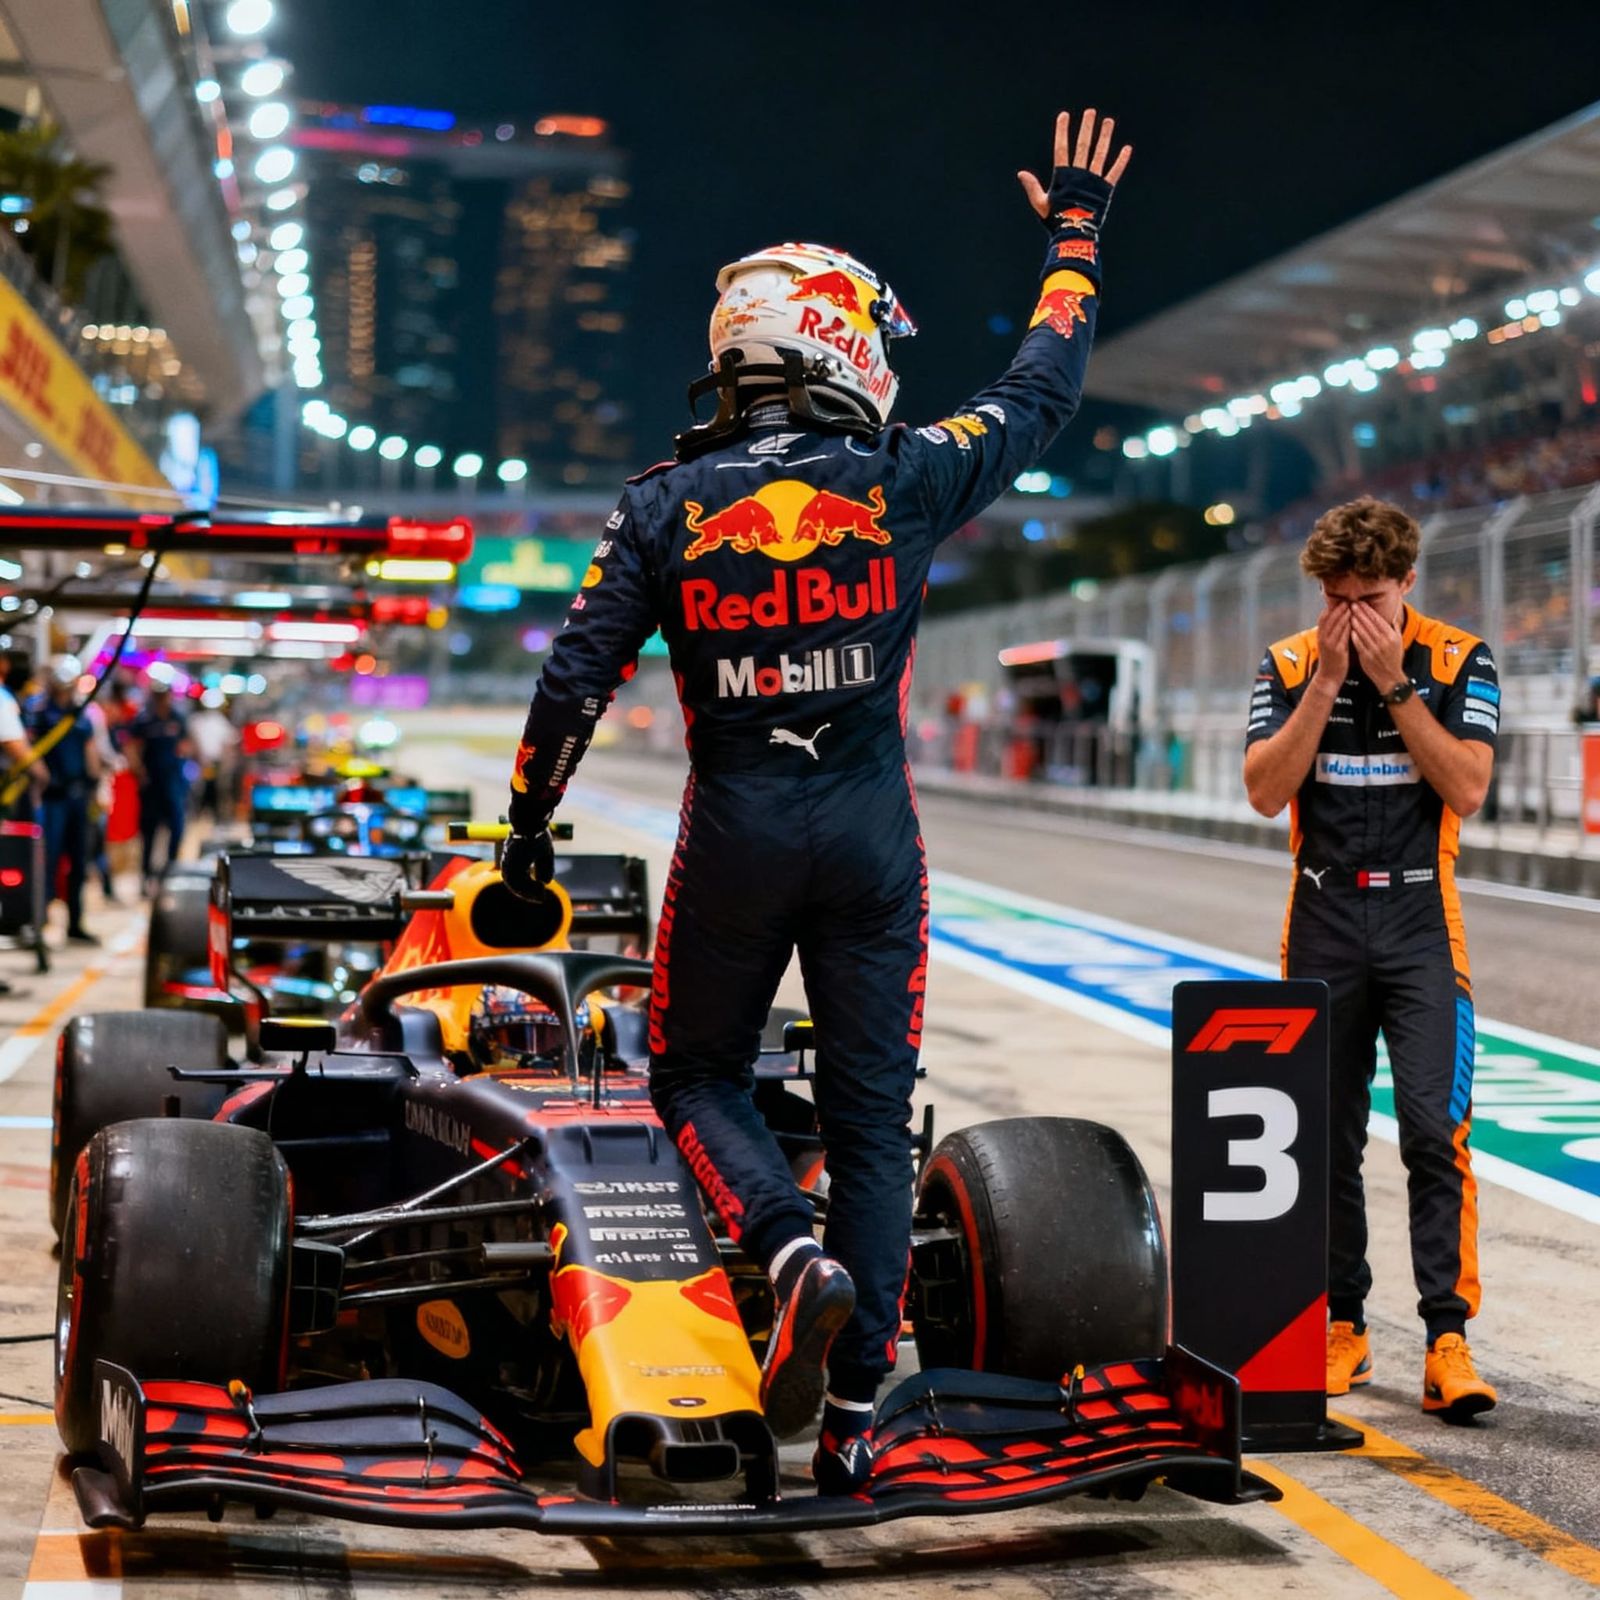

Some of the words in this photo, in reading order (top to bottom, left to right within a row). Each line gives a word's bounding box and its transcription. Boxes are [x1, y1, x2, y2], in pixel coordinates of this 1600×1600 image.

[680, 568, 789, 631] Red
[796, 556, 897, 624] Bull
[1203, 1085, 1300, 1221] 3
